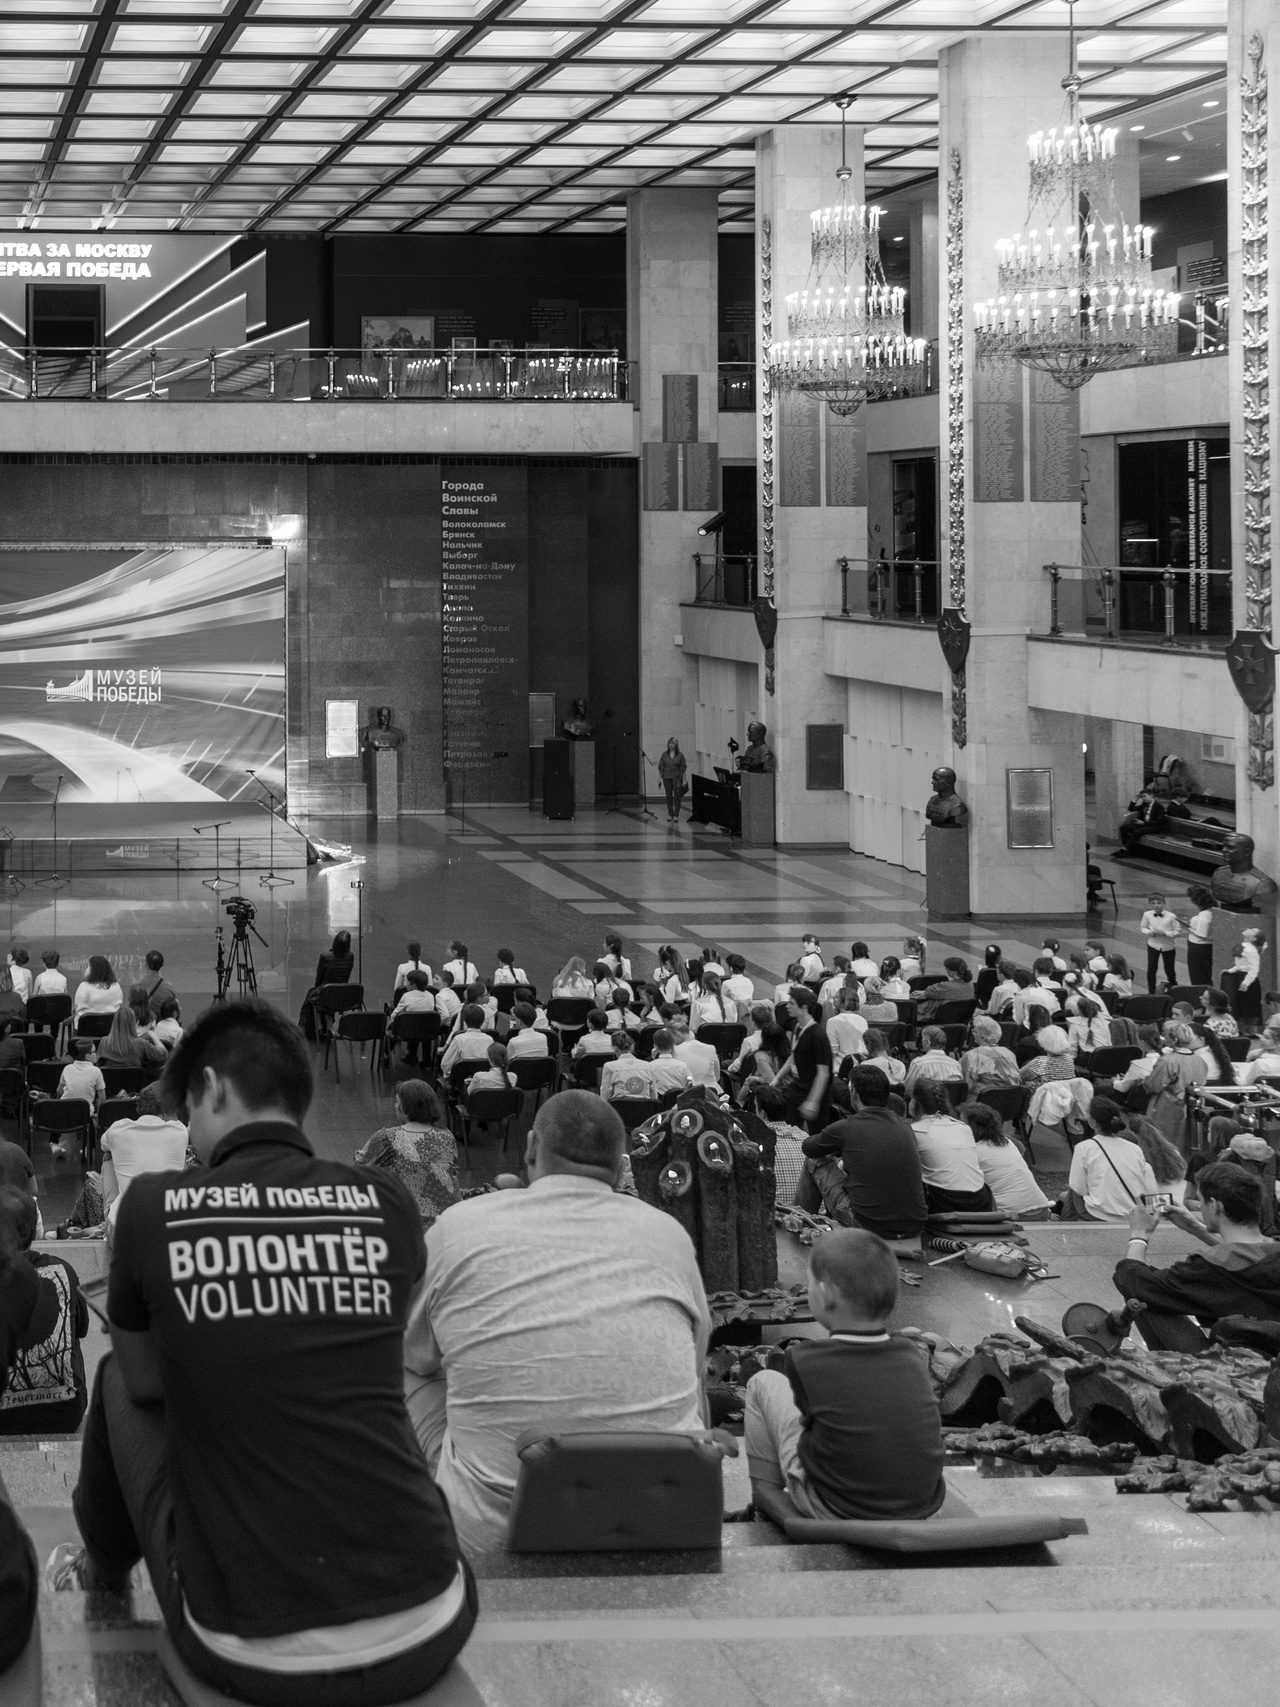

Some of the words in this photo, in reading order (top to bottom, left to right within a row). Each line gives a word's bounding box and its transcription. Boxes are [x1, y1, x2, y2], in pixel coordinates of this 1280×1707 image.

[46, 243, 71, 257] ЗА
[76, 244, 152, 258] МОСКВУ
[66, 262, 152, 280] ПОБЕДА
[1198, 440, 1207, 480] НАЦИЗМУ
[442, 481, 484, 492] Города
[442, 494, 498, 503] Воинской
[1188, 478, 1196, 512] AGAINST
[442, 506, 479, 515] Славы
[1199, 483, 1208, 554] СОПРОТИВЛЕНИЕ
[442, 520, 506, 528] Волоколамск
[442, 531, 476, 540] Брянск
[442, 551, 478, 560] Выборг
[442, 562, 516, 571] Калач-на-Дону
[442, 573, 503, 581] Владивосток
[442, 593, 469, 602] Тверь
[443, 614, 484, 622] Колпино
[443, 624, 478, 633] Старый
[481, 624, 510, 632] Оскол
[443, 635, 478, 644] Ковров
[443, 646, 496, 654] Ломоносов
[97, 666, 162, 685] МУЗЕЙ
[97, 686, 162, 704] ПОБЕДЫ
[443, 698, 488, 706] Можайс
[164, 1183, 259, 1212] МУЗЕЙ
[266, 1184, 380, 1210] ПОБЕДЫ
[168, 1228, 388, 1281] ВОЛОНТЁР
[174, 1276, 392, 1323] VOLUNTEER
